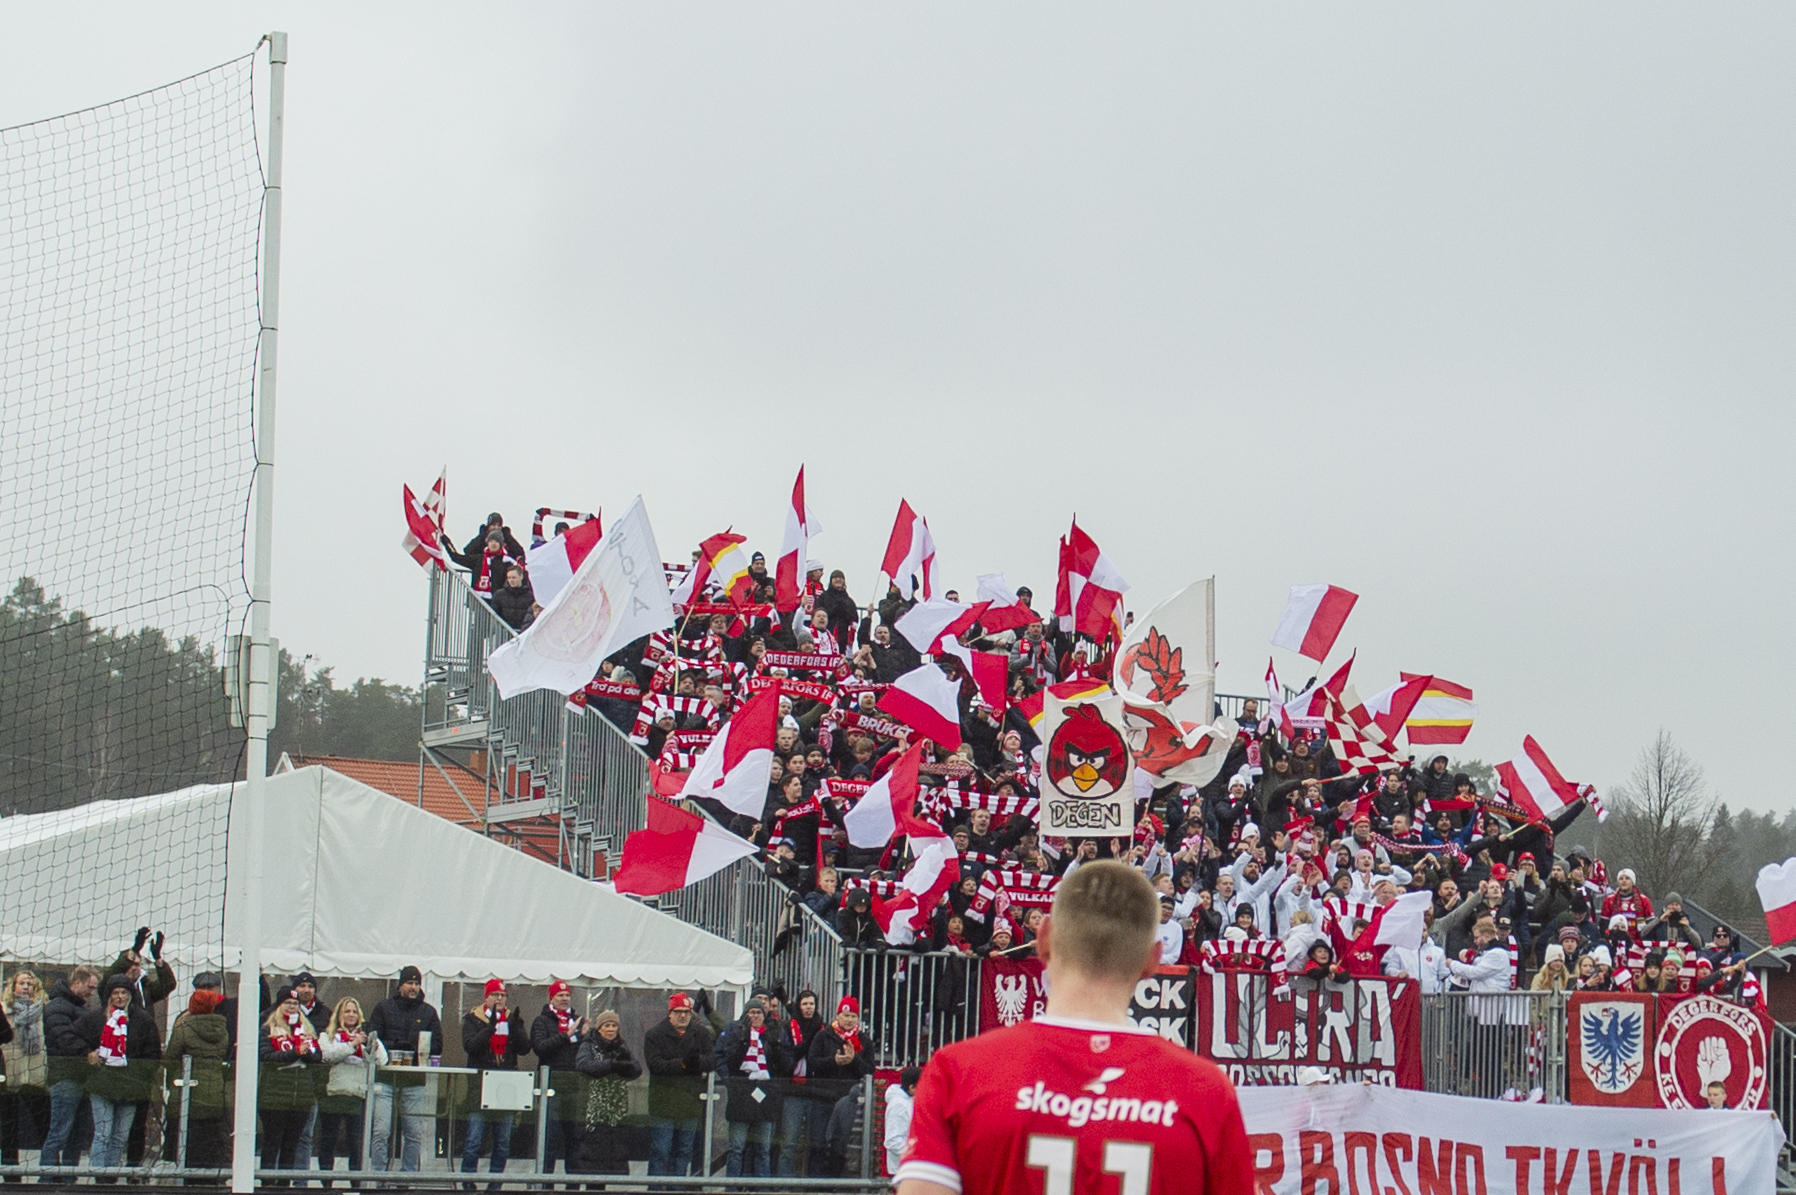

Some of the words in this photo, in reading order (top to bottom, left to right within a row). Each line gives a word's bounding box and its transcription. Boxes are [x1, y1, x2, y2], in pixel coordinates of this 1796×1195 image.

[766, 654, 827, 666] DEGERFORS
[829, 657, 841, 667] IF
[821, 690, 833, 700] IF
[679, 734, 717, 744] VULK
[857, 715, 914, 738] BRUKET
[1050, 801, 1121, 829] DEGEN
[1134, 978, 1187, 1010] CK
[1671, 999, 1757, 1036] DEGERFORS
[1015, 1080, 1179, 1128] skogsmat
